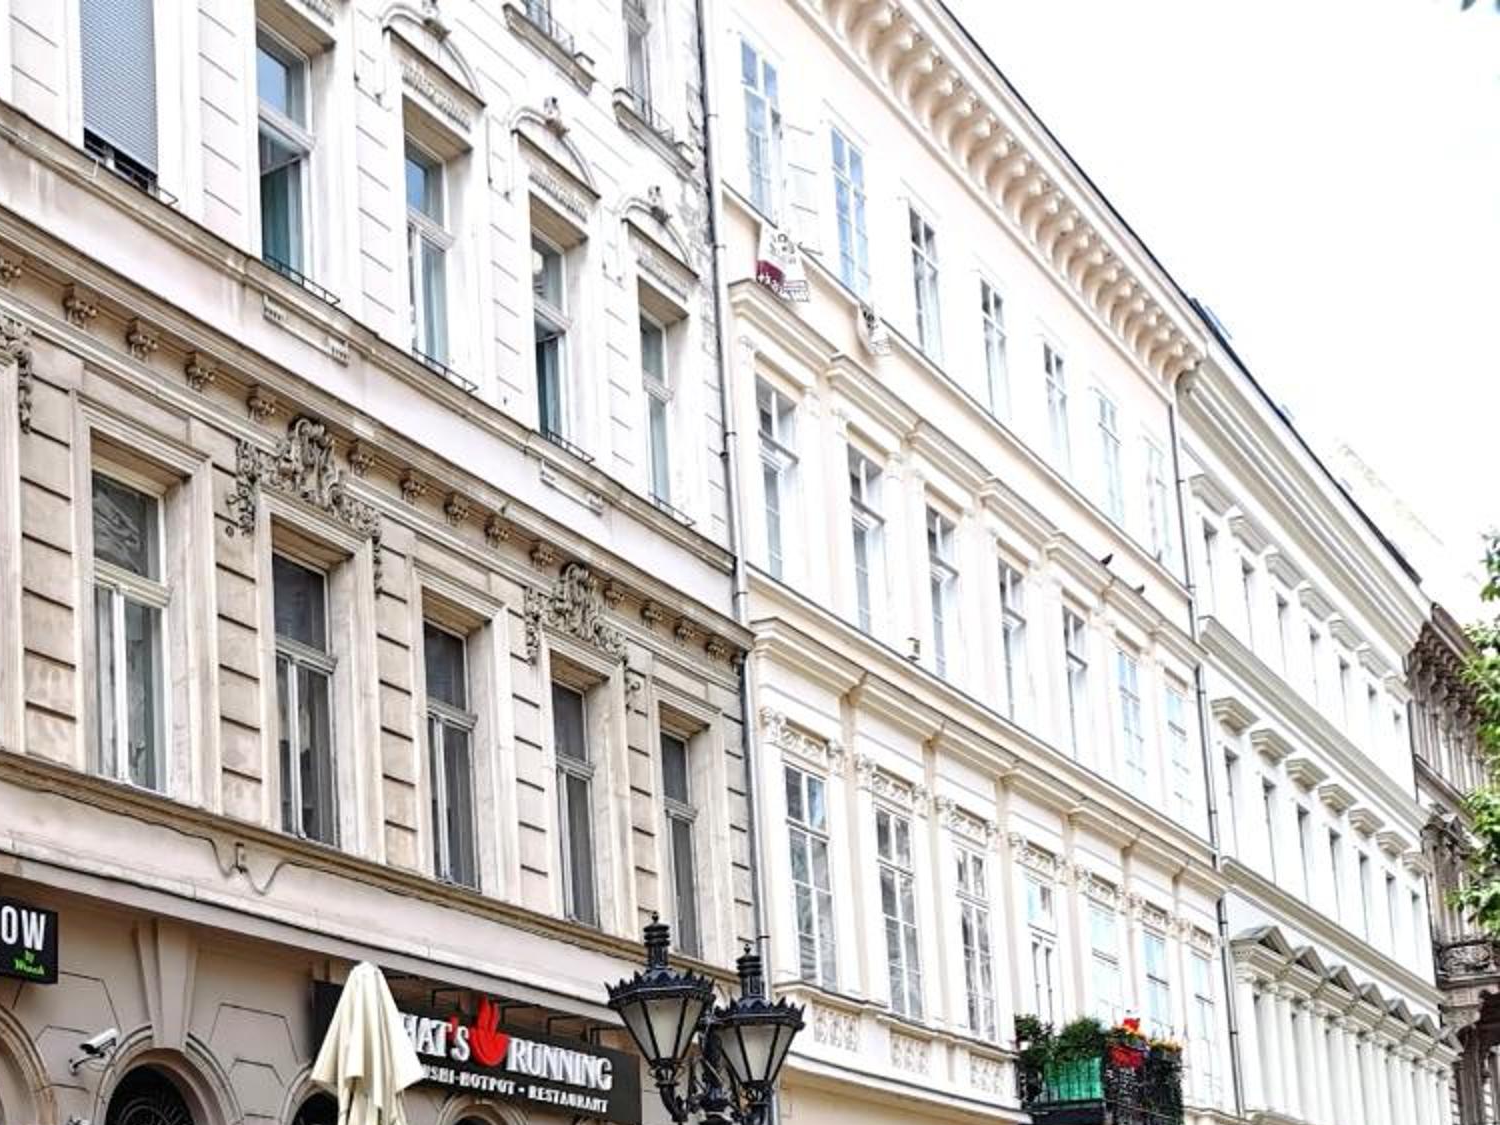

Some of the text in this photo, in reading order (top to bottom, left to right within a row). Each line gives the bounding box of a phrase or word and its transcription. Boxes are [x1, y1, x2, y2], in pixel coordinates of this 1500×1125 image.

[400, 1011, 613, 1092] HAT'S RUNNING
[527, 1084, 609, 1114] RESTAURANT
